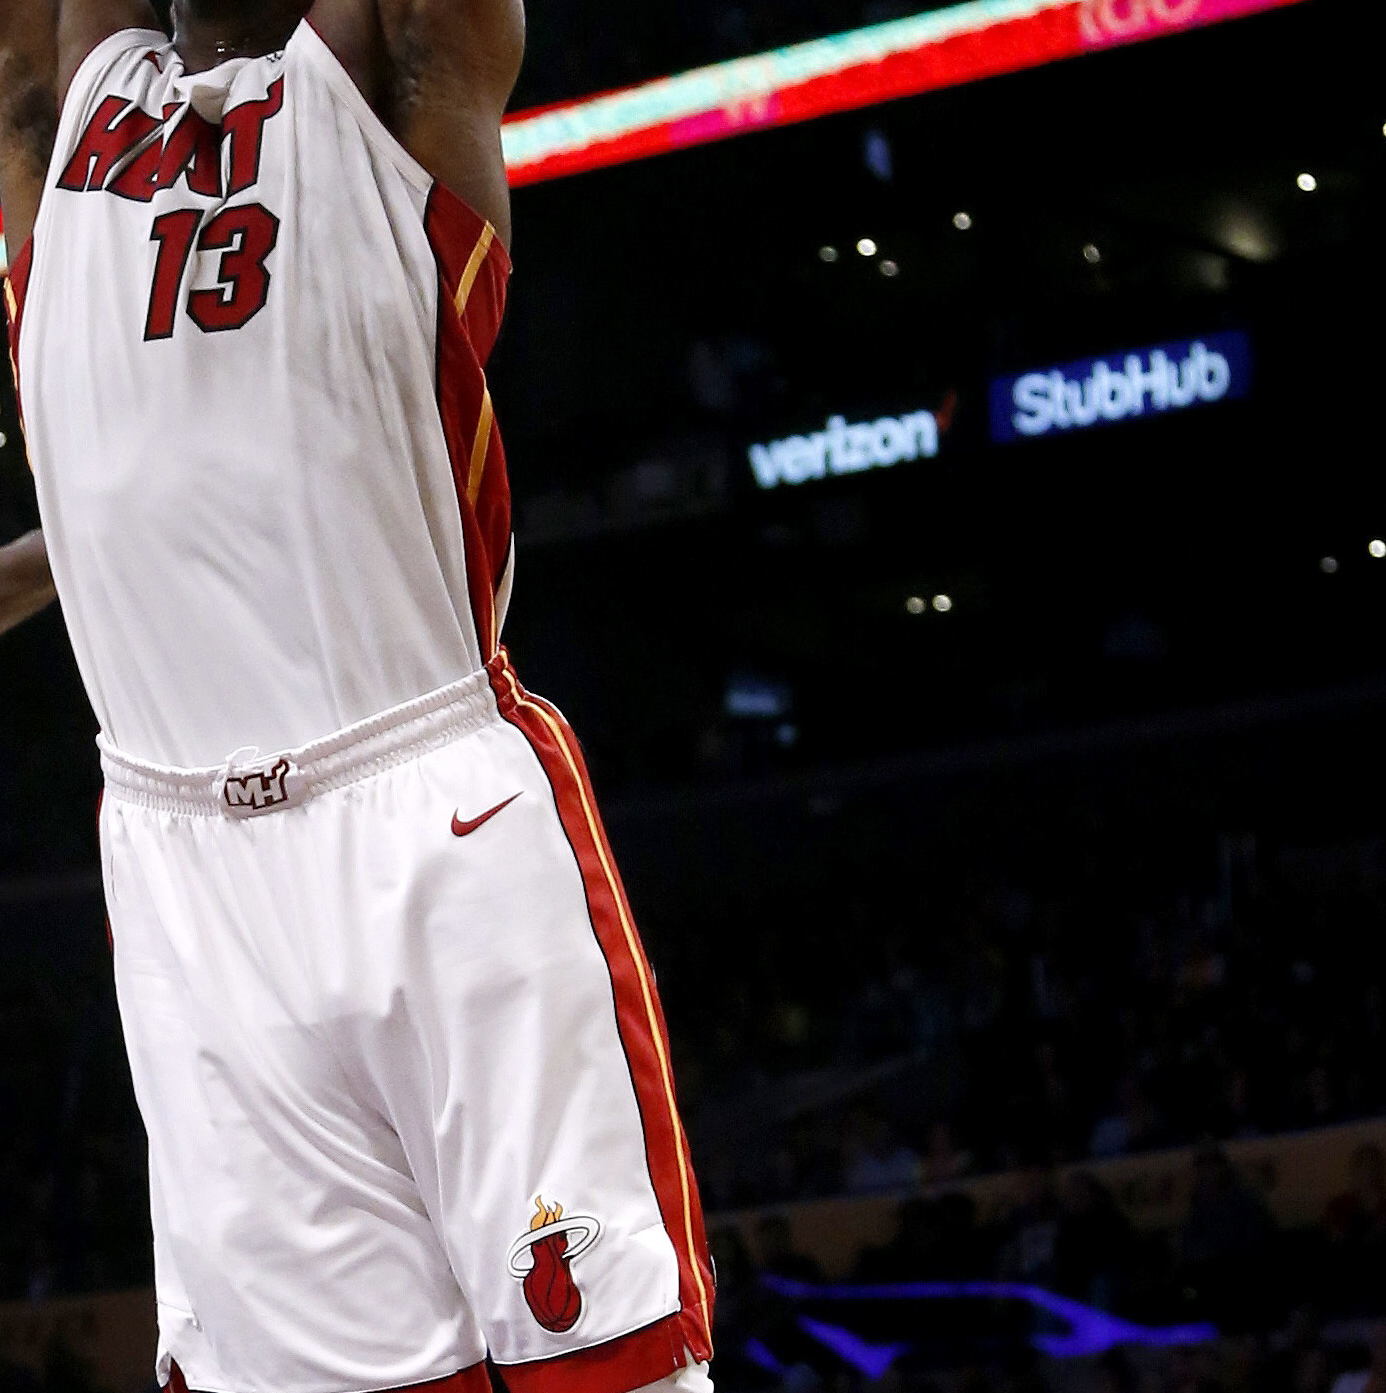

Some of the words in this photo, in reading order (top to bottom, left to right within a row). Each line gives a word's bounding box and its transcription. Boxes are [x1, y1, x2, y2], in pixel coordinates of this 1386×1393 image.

[143, 203, 281, 342] 13
[1013, 340, 1233, 436] StubHub
[748, 409, 940, 489] verizon
